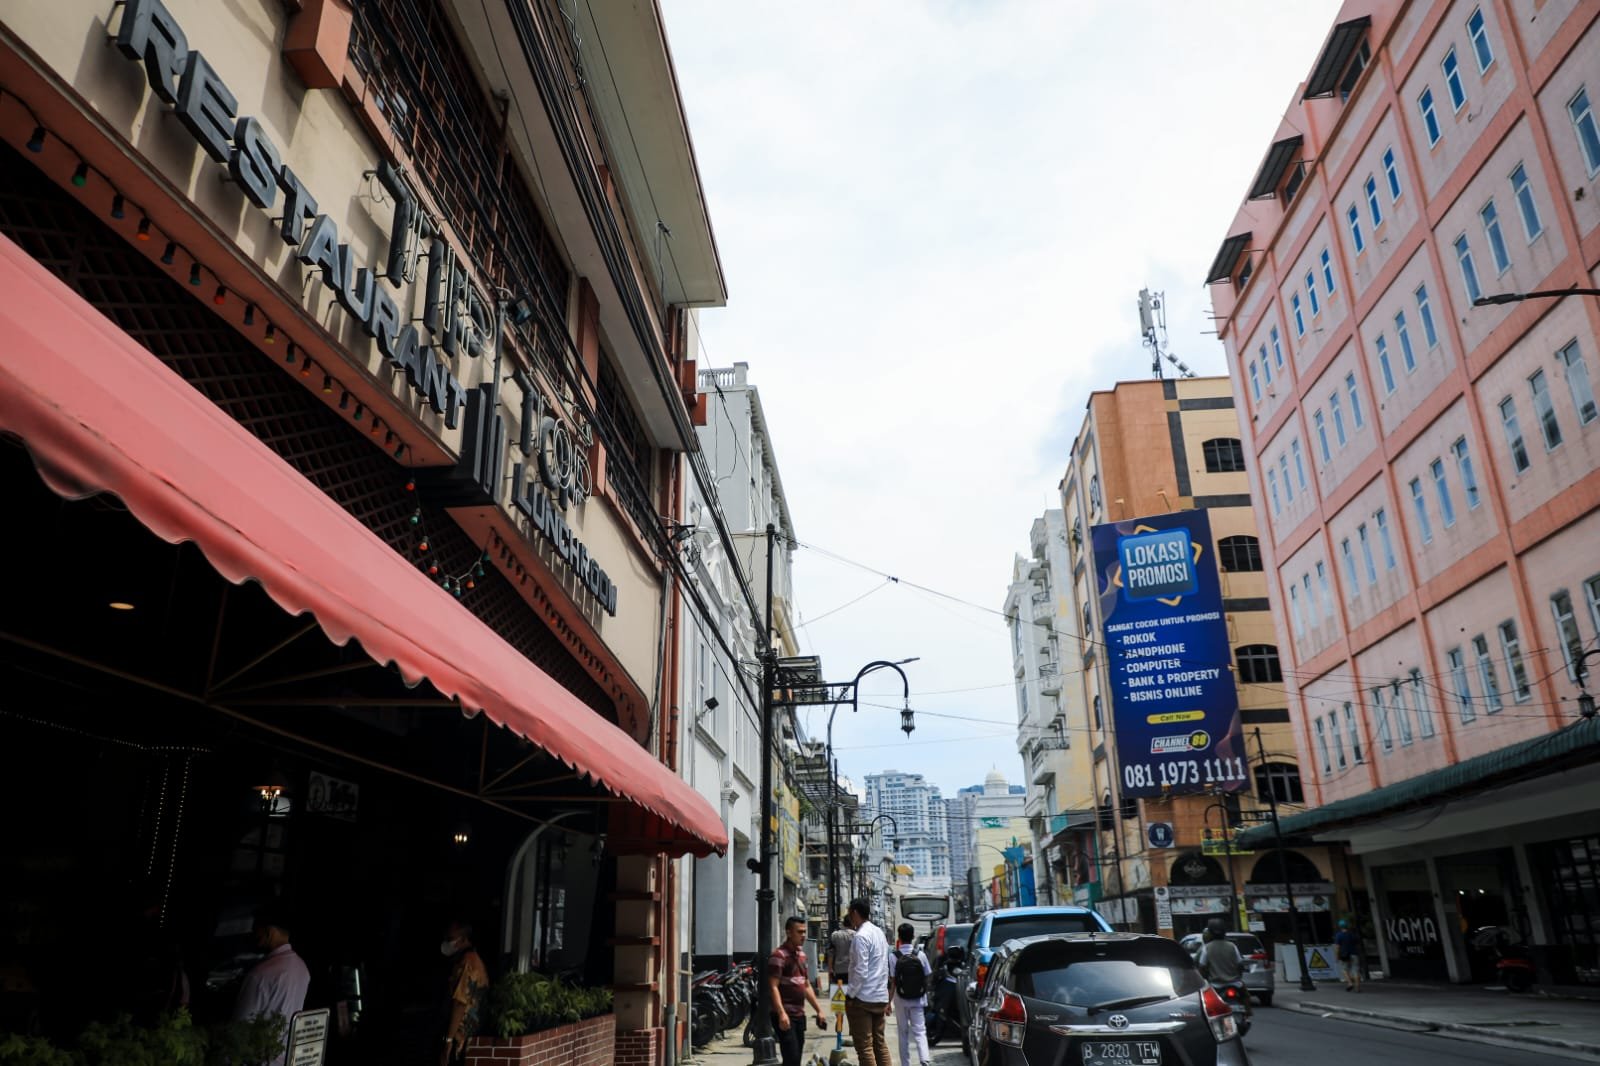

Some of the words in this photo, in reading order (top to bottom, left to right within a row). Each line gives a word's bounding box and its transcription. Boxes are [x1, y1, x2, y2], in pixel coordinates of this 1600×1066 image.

[117, 0, 467, 430] RESTAURANT
[511, 462, 618, 617] LUNCHROOM
[1125, 540, 1185, 567] LOKASI
[1128, 562, 1188, 588] PROMOSI
[1107, 622, 1134, 632] SANGAT
[1135, 619, 1160, 629] COCOK
[1160, 615, 1185, 626] UNTUK
[1186, 611, 1220, 622] PROMOSI
[1123, 632, 1157, 645] ROKOK
[1125, 643, 1186, 659] HANDPHONE
[1126, 658, 1182, 673] COMPUTER
[1128, 675, 1155, 687] BANK
[1157, 674, 1165, 685] &
[1167, 668, 1220, 684] PROPERTY
[1130, 689, 1163, 702] BISNIS
[1165, 685, 1203, 699] ONLINE
[1153, 737, 1190, 748] CHANNEL
[1124, 763, 1155, 788] 081
[1158, 759, 1200, 785] 1973
[1203, 756, 1247, 782] 1111
[1385, 917, 1438, 942] KAMA
[1084, 1044, 1093, 1058] B
[1100, 1043, 1130, 1058] 2820
[1136, 1042, 1160, 1057] TFW
